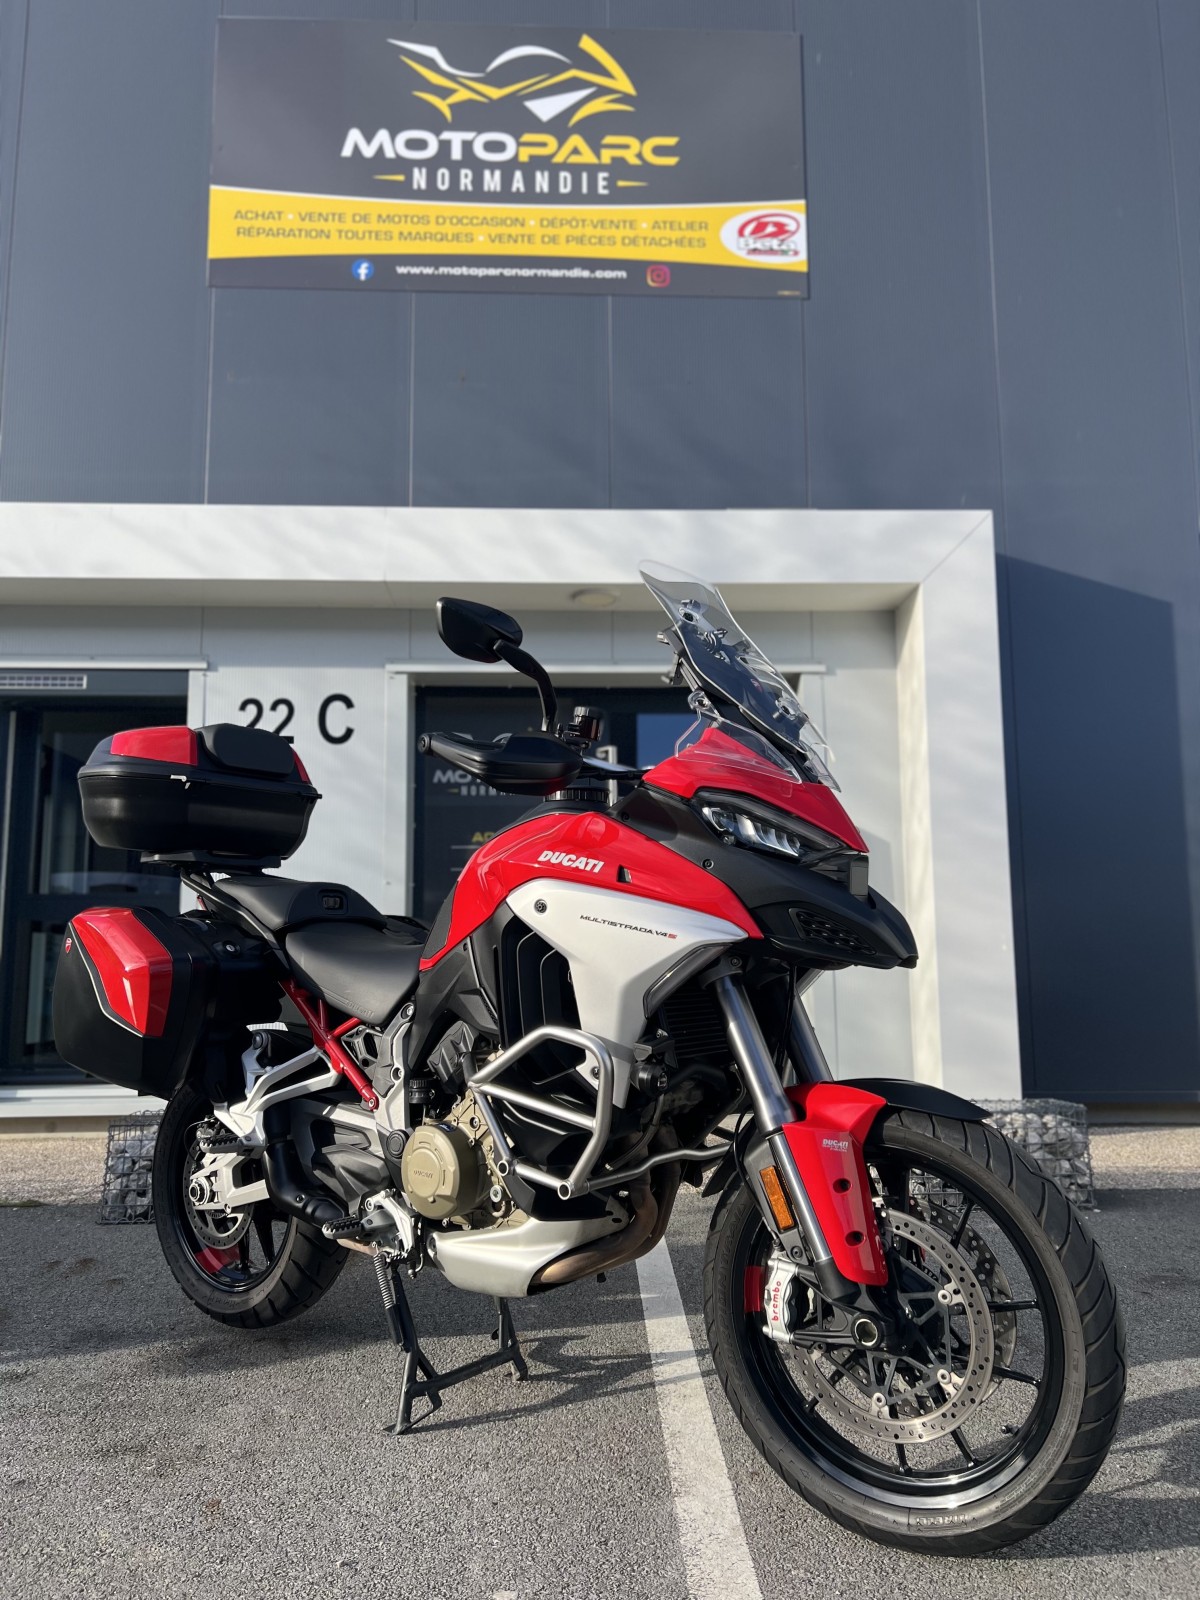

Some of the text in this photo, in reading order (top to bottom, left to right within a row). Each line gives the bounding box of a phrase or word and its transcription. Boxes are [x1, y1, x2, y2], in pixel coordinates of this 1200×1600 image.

[340, 127, 680, 166] MOTOPARC
[412, 167, 610, 194] NORMANDIE
[234, 209, 284, 222] ACHAT
[298, 211, 347, 224] VENTE
[351, 213, 372, 224] DE
[377, 213, 431, 226] MOTOS
[435, 215, 526, 228] D'OCCASION
[651, 220, 709, 232] ATELIER
[236, 225, 331, 240] RÉPARATION
[336, 229, 393, 241] TOUTES
[398, 230, 474, 244] MARQUES
[488, 233, 537, 245] VENTE
[541, 234, 561, 245] DE
[621, 233, 707, 249] DÉTACHÉES
[395, 265, 627, 279] www.motoparcnormandie.com
[238, 693, 355, 745] 22 C
[537, 850, 605, 873] DUCATI
[579, 914, 678, 940] MULTISTRADA V4S
[822, 1138, 849, 1149] DUCATI
[771, 1280, 782, 1322] brembo
